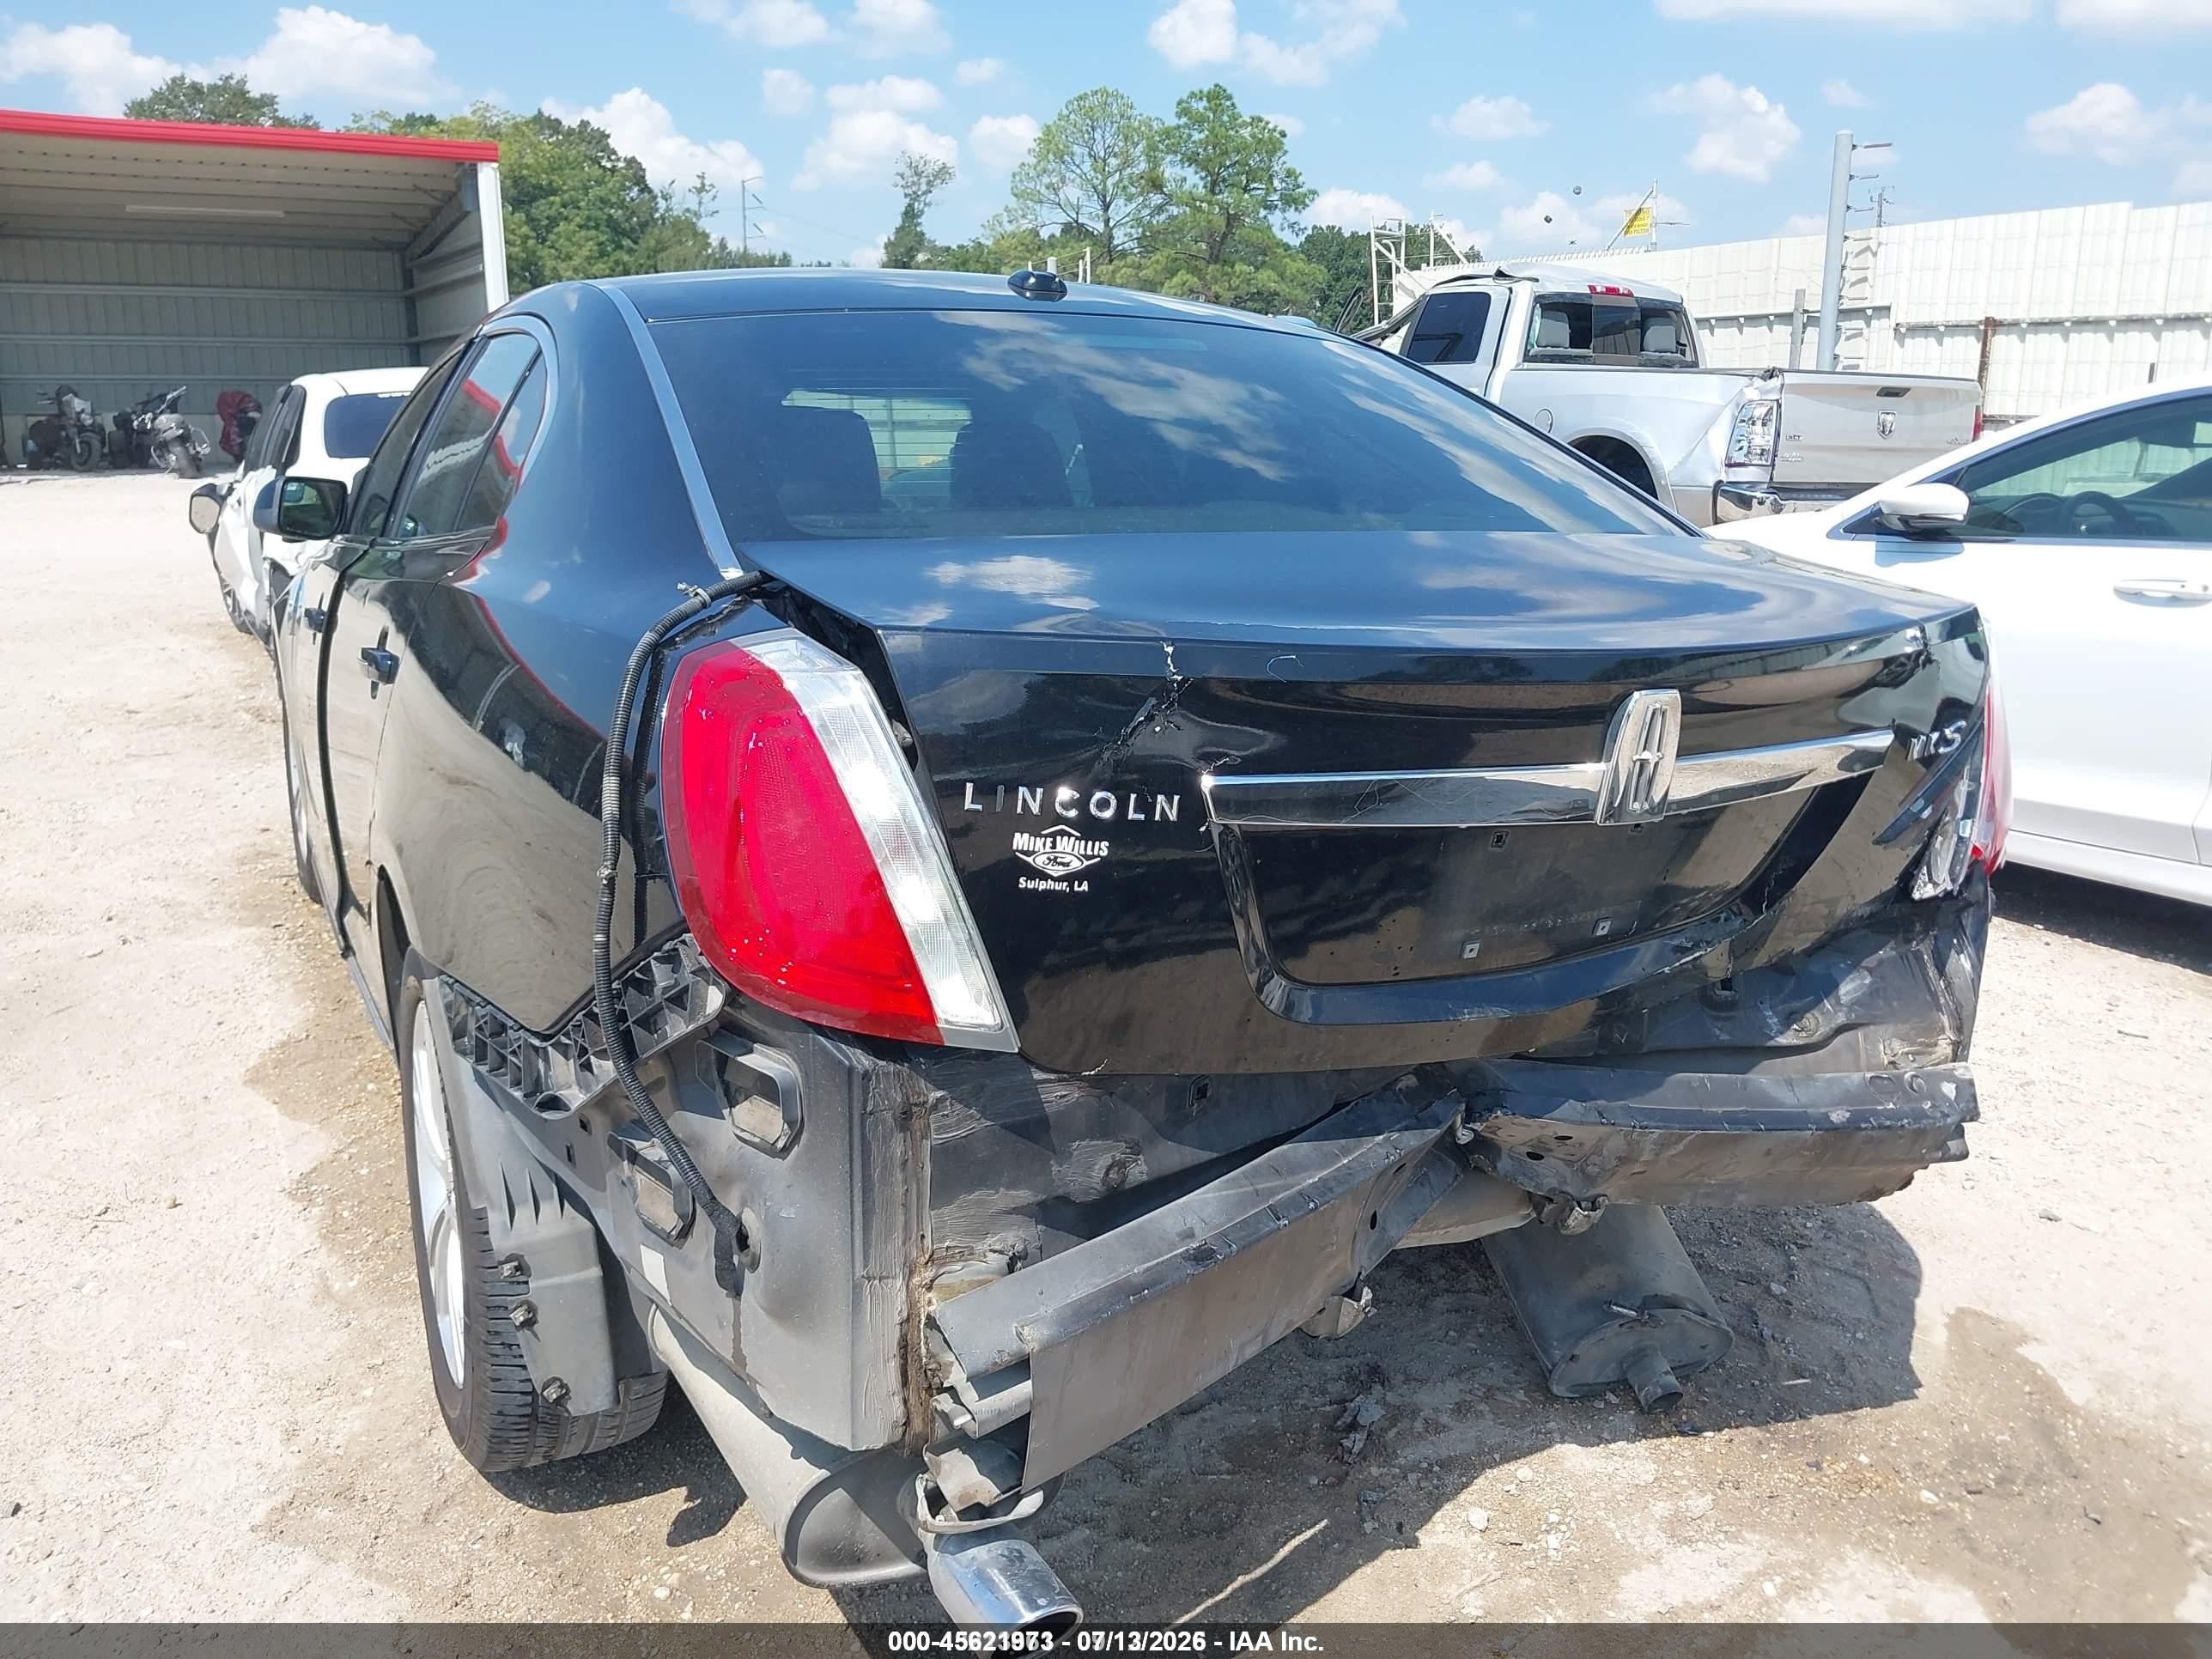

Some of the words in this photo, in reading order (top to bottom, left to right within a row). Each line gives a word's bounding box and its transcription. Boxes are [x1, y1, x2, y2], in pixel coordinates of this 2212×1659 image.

[963, 781, 1182, 822] LINCOLN
[1012, 832, 1054, 852] MIKE
[1055, 836, 1109, 856] WILLIS
[1042, 854, 1073, 867] Ford
[1018, 877, 1070, 893] Sulphur,
[1073, 880, 1089, 891] LA
